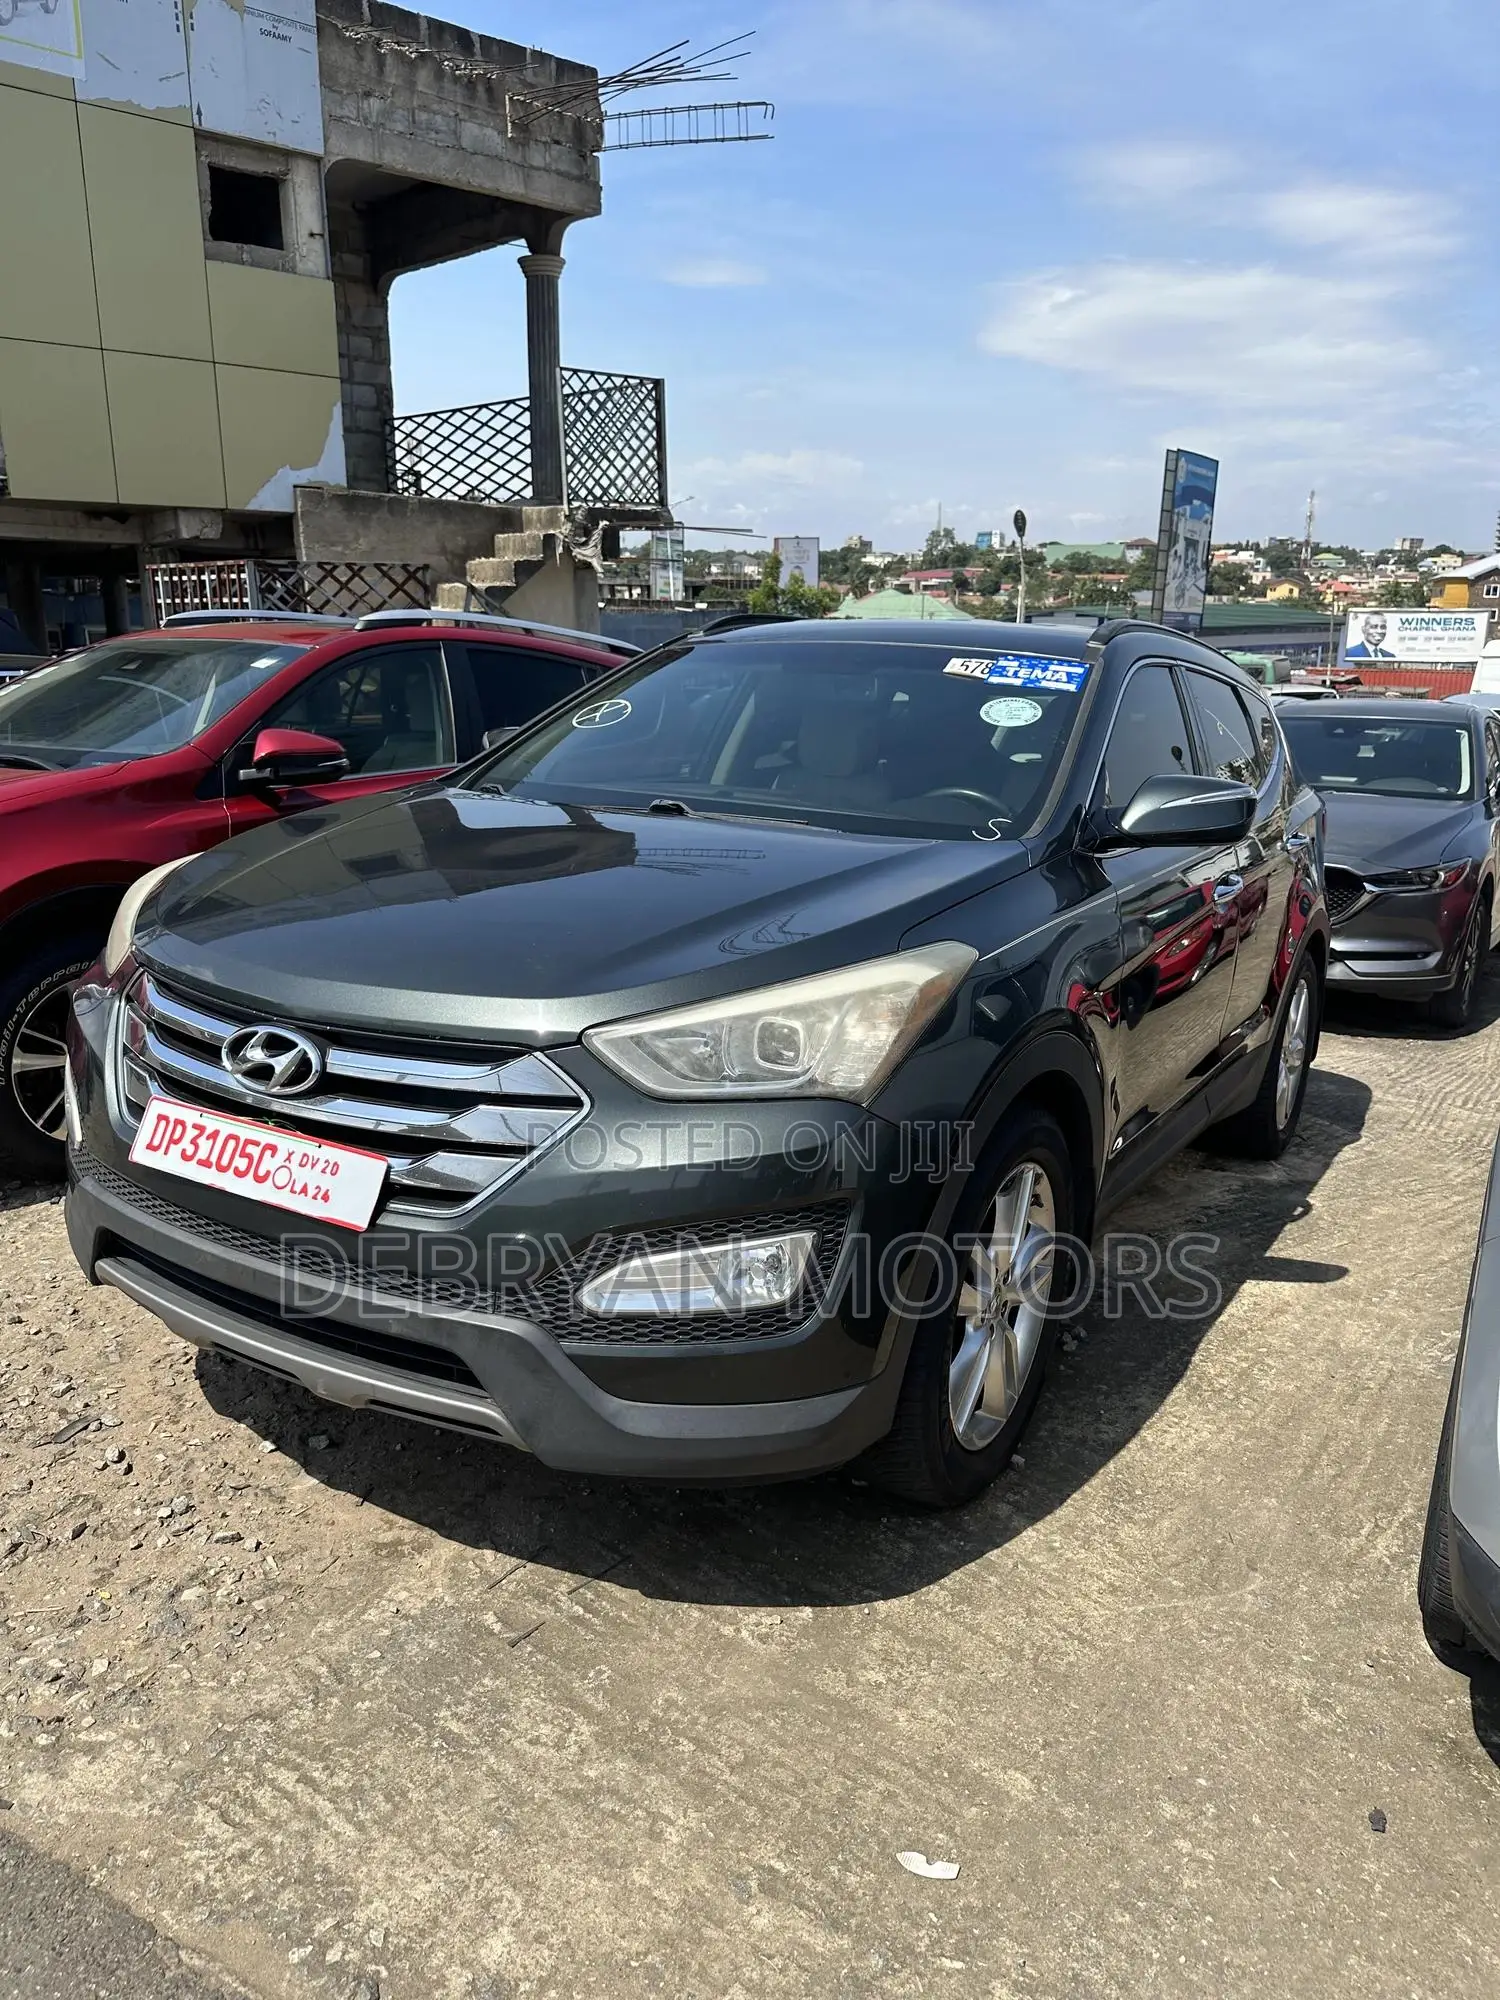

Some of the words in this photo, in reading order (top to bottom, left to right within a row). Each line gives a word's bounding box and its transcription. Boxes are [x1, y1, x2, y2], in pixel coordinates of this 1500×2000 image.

[259, 27, 293, 43] SOFAAMY
[272, 23, 279, 31] by
[1400, 617, 1475, 626] WINNERS
[1005, 666, 1069, 683] TEMA
[146, 1113, 278, 1184] DP3105C
[298, 1152, 320, 1170] DV
[321, 1159, 340, 1176] 20
